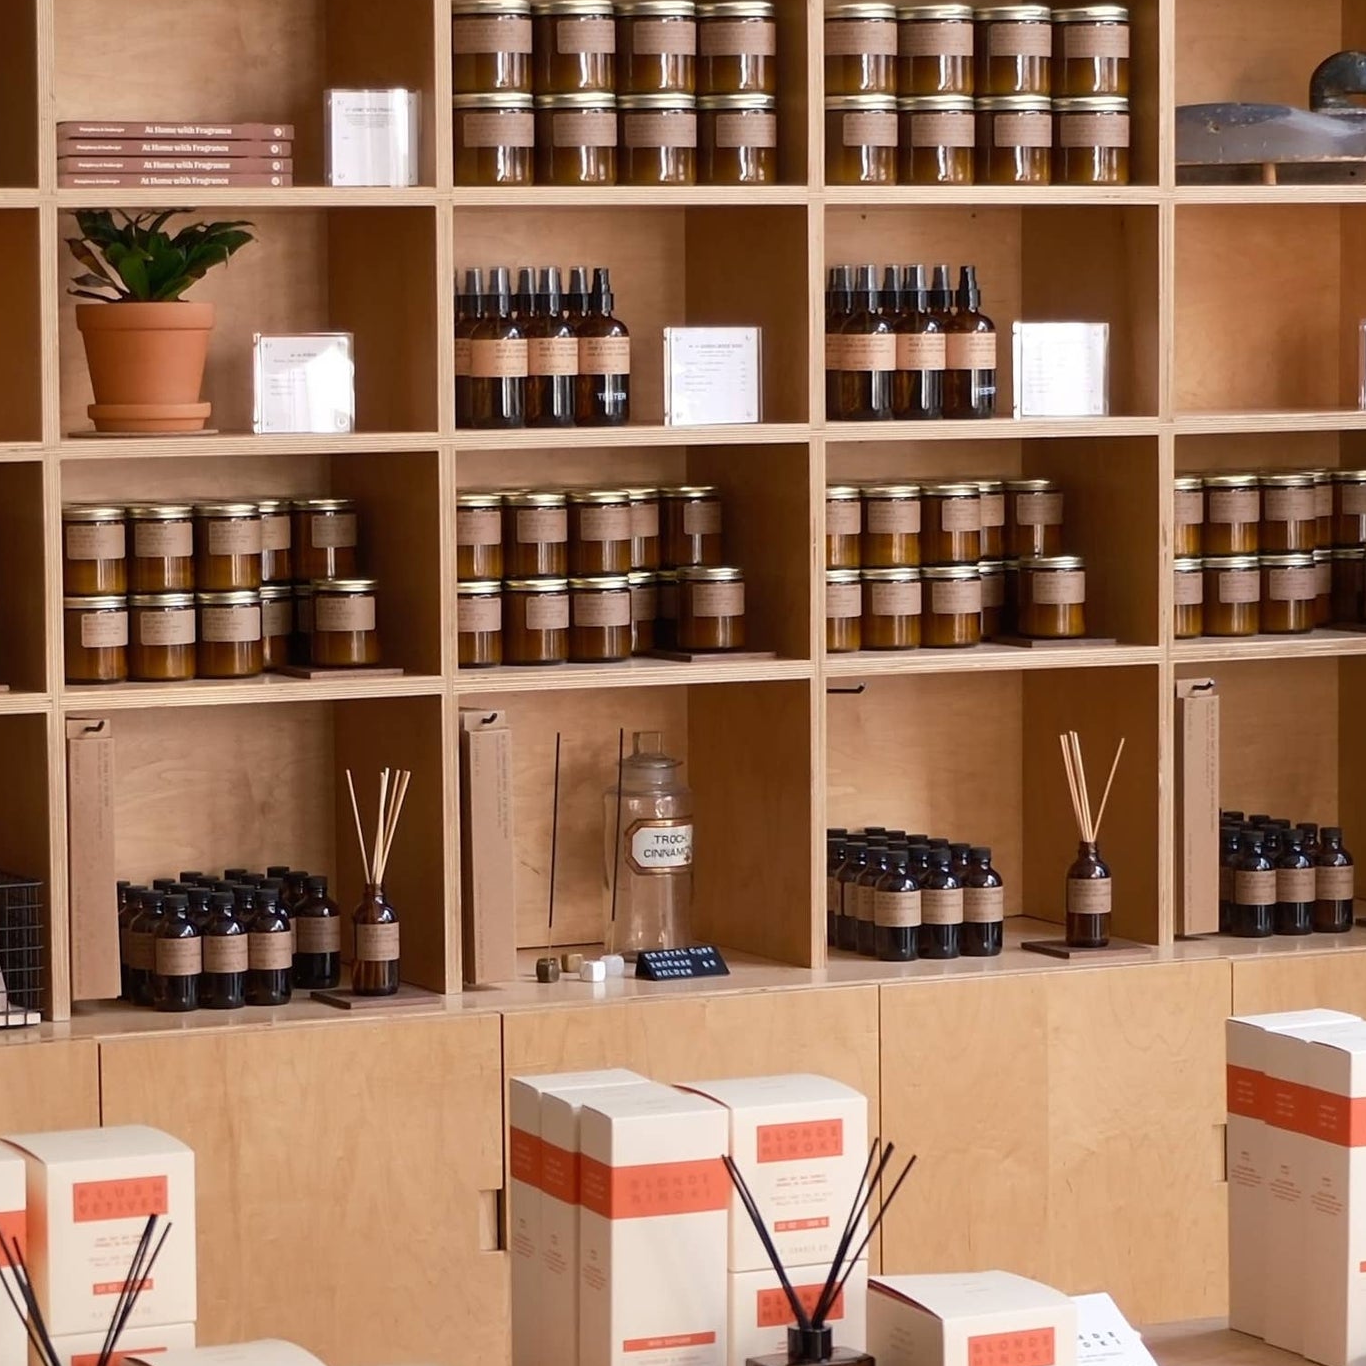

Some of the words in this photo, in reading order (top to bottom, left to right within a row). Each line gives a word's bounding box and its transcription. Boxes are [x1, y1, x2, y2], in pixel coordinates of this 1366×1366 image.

[195, 126, 232, 136] Fragrance
[192, 144, 229, 153] Fragrance
[194, 162, 231, 171] Fragrance
[192, 177, 229, 186] Fragrance
[597, 392, 627, 401] TTER
[644, 949, 688, 960] CRYSTAL
[649, 959, 693, 969] INCENSE
